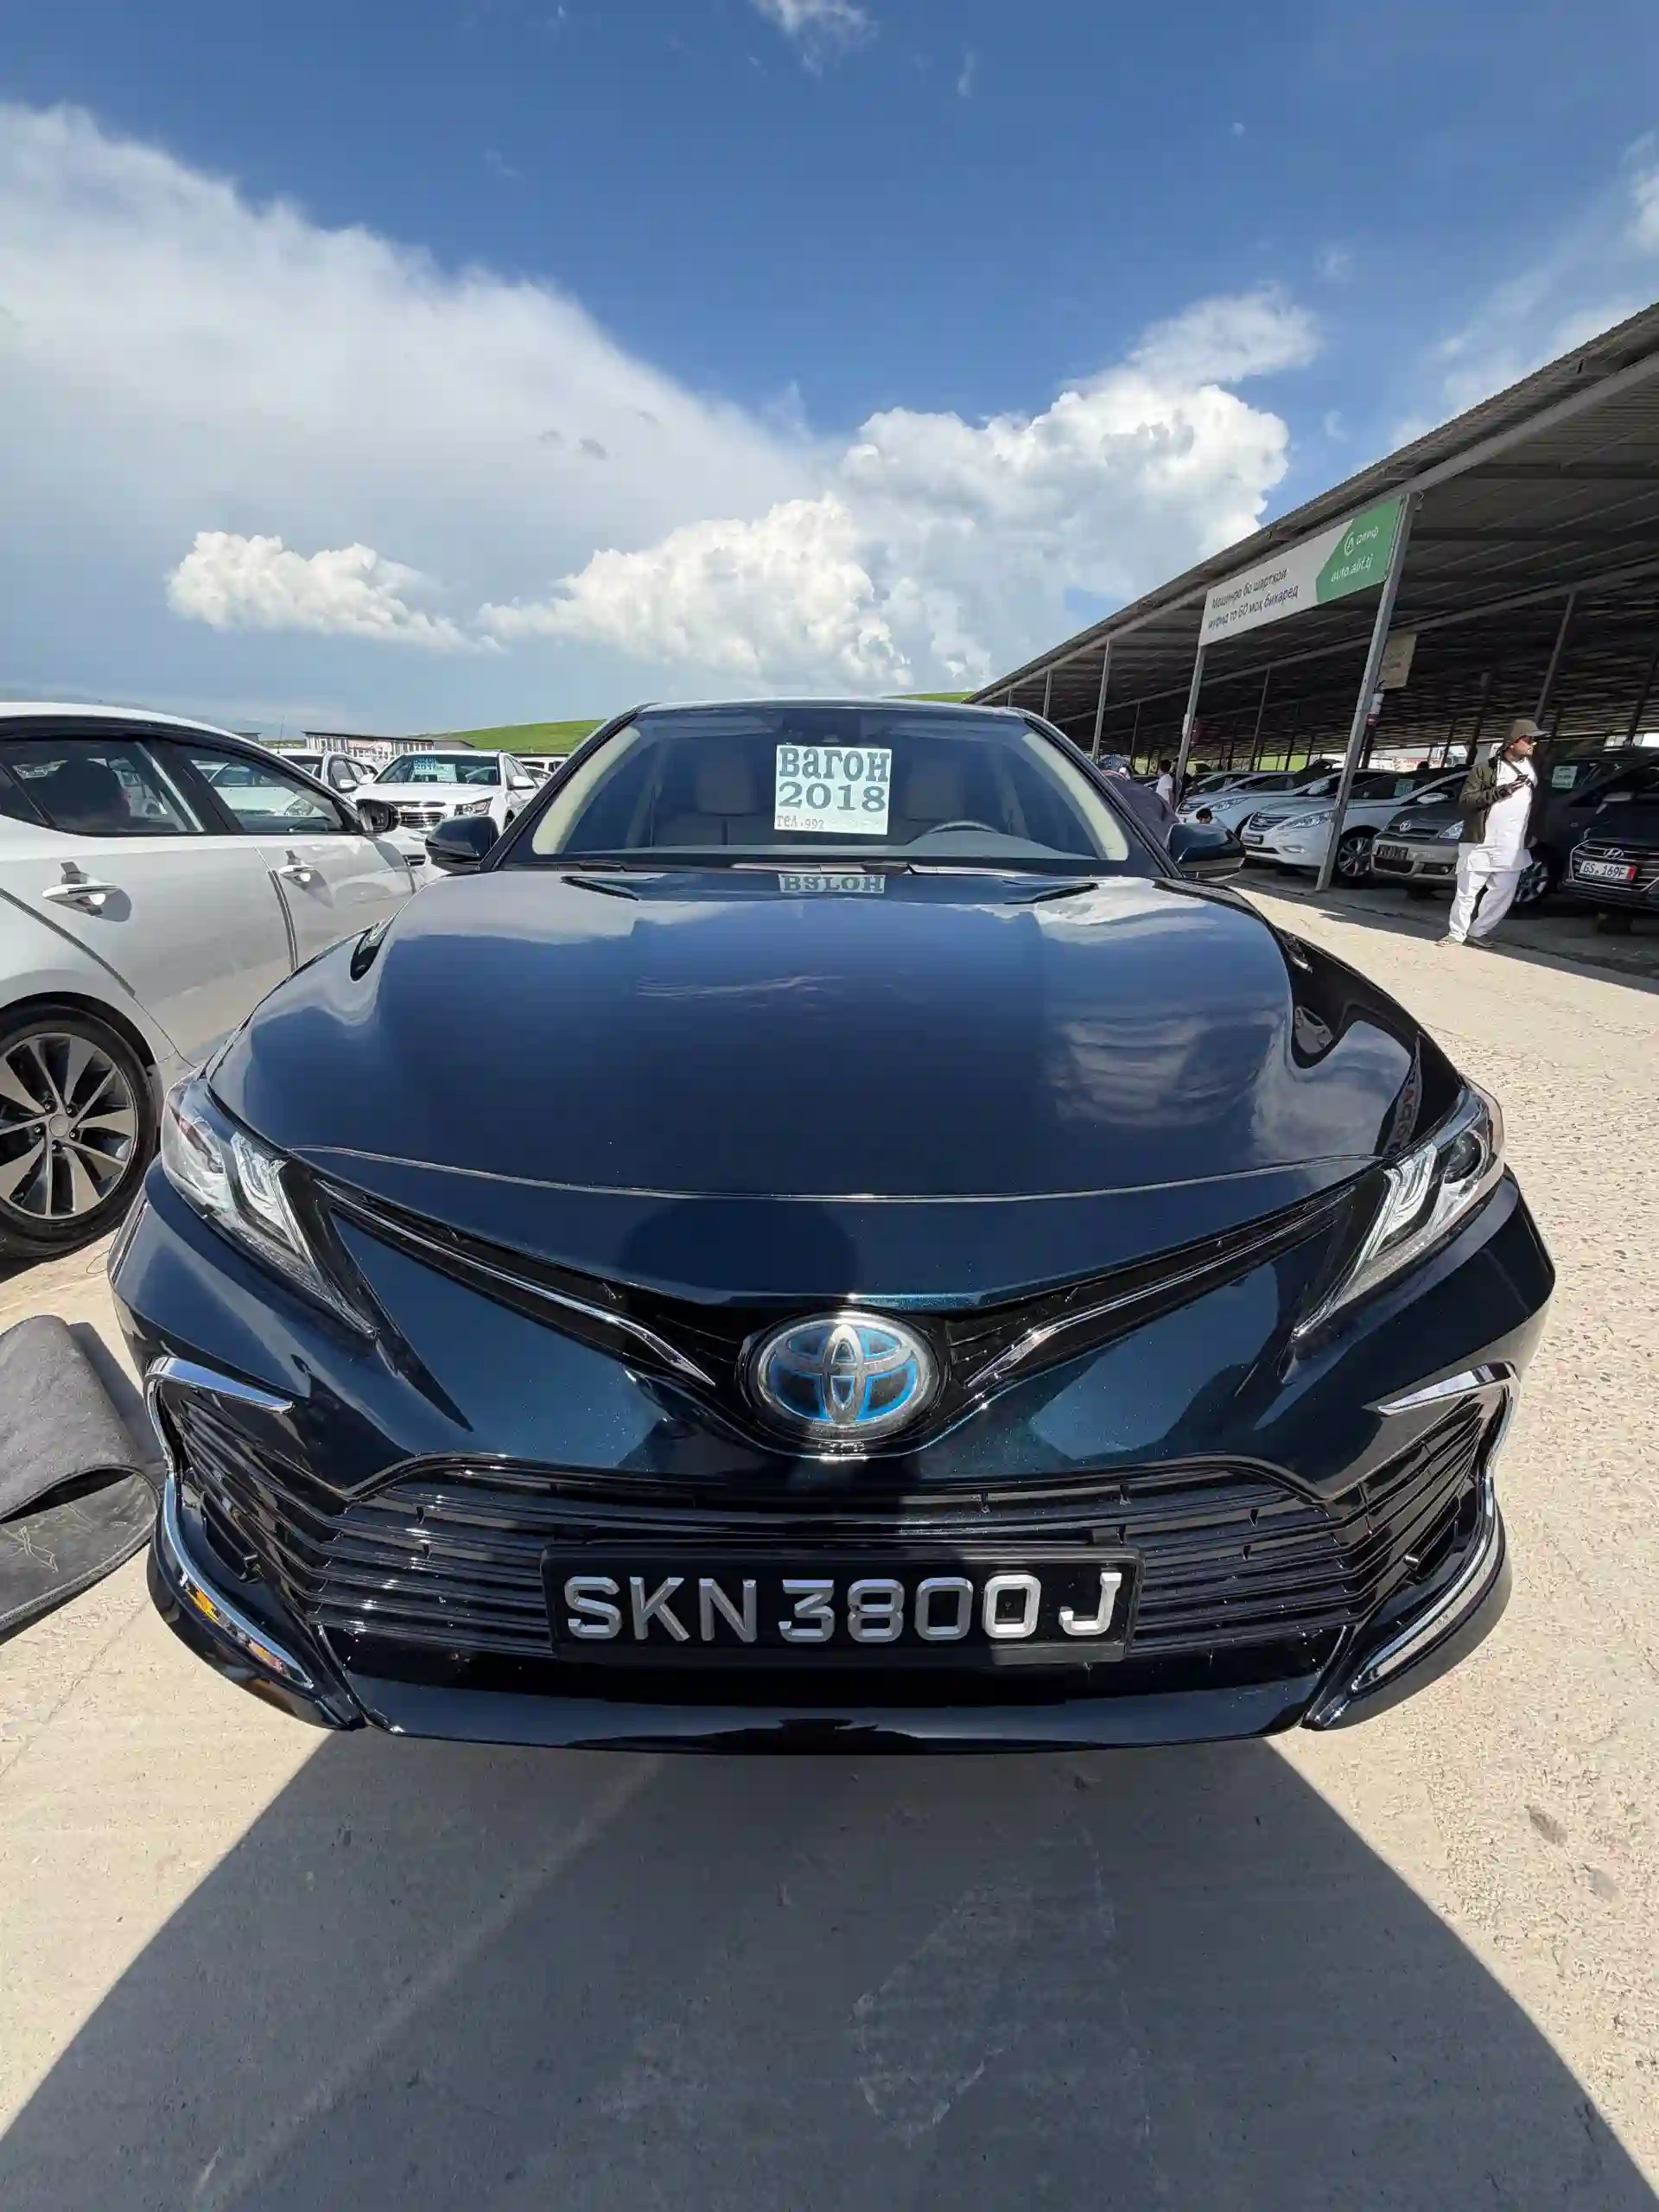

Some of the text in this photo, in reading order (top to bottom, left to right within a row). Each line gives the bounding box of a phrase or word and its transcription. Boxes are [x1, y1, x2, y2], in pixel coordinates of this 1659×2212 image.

[1331, 553, 1374, 582] auto.alif.tj
[779, 781, 886, 812] 2018
[564, 1576, 758, 1642] SKN
